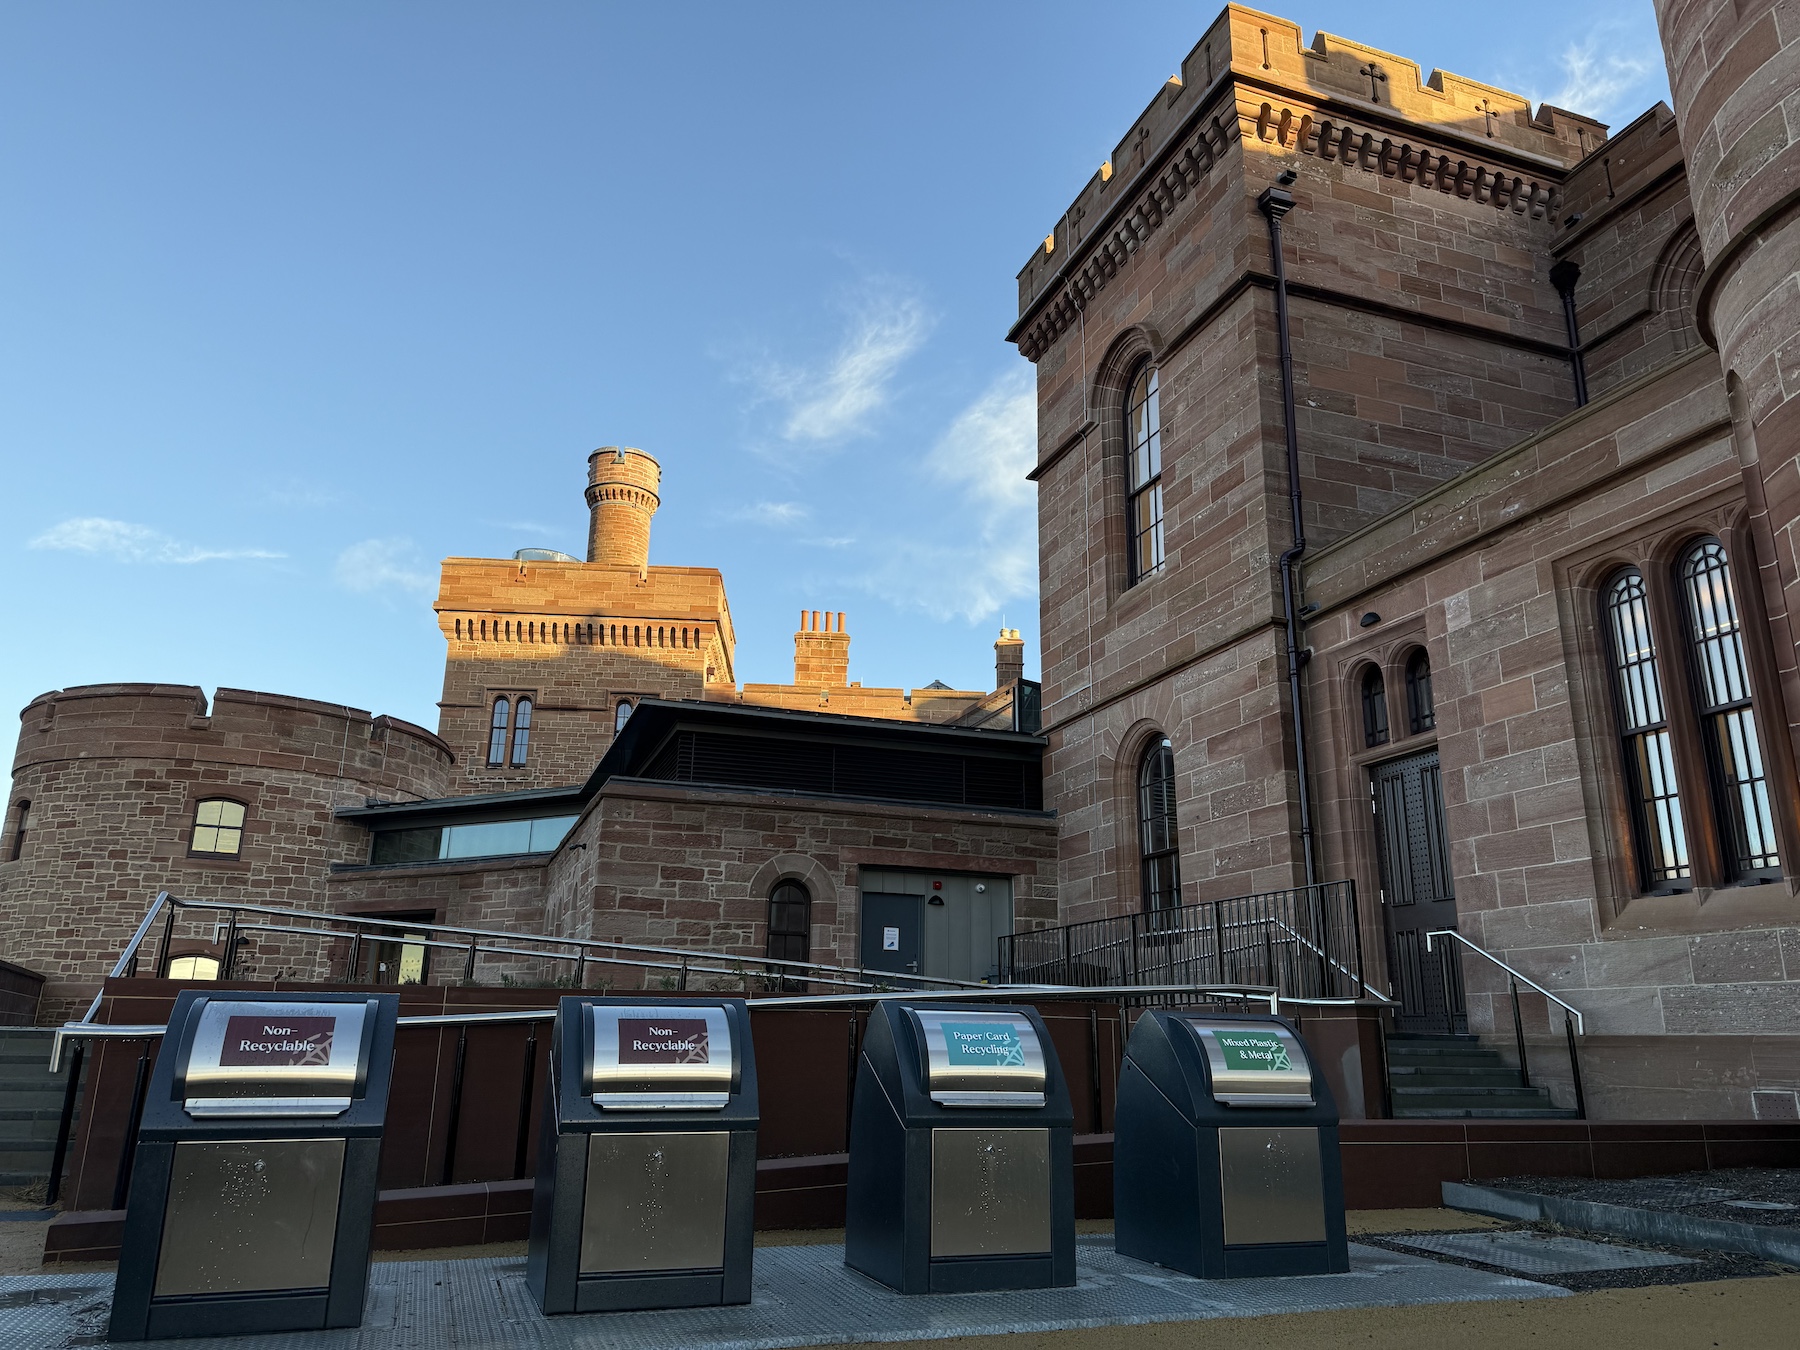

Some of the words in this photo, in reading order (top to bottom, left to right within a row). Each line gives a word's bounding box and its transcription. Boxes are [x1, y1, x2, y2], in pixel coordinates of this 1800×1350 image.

[262, 1025, 298, 1035] Non-
[649, 1027, 678, 1036] Non-
[953, 1031, 1011, 1041] Paper/Card
[239, 1040, 315, 1053] Recyclable
[633, 1040, 695, 1052] Recyclable
[1222, 1038, 1250, 1047] Mixed
[1249, 1039, 1278, 1048] Plastic
[961, 1044, 1010, 1056] Recycling
[1239, 1050, 1248, 1059] &
[1248, 1050, 1273, 1060] Metal
